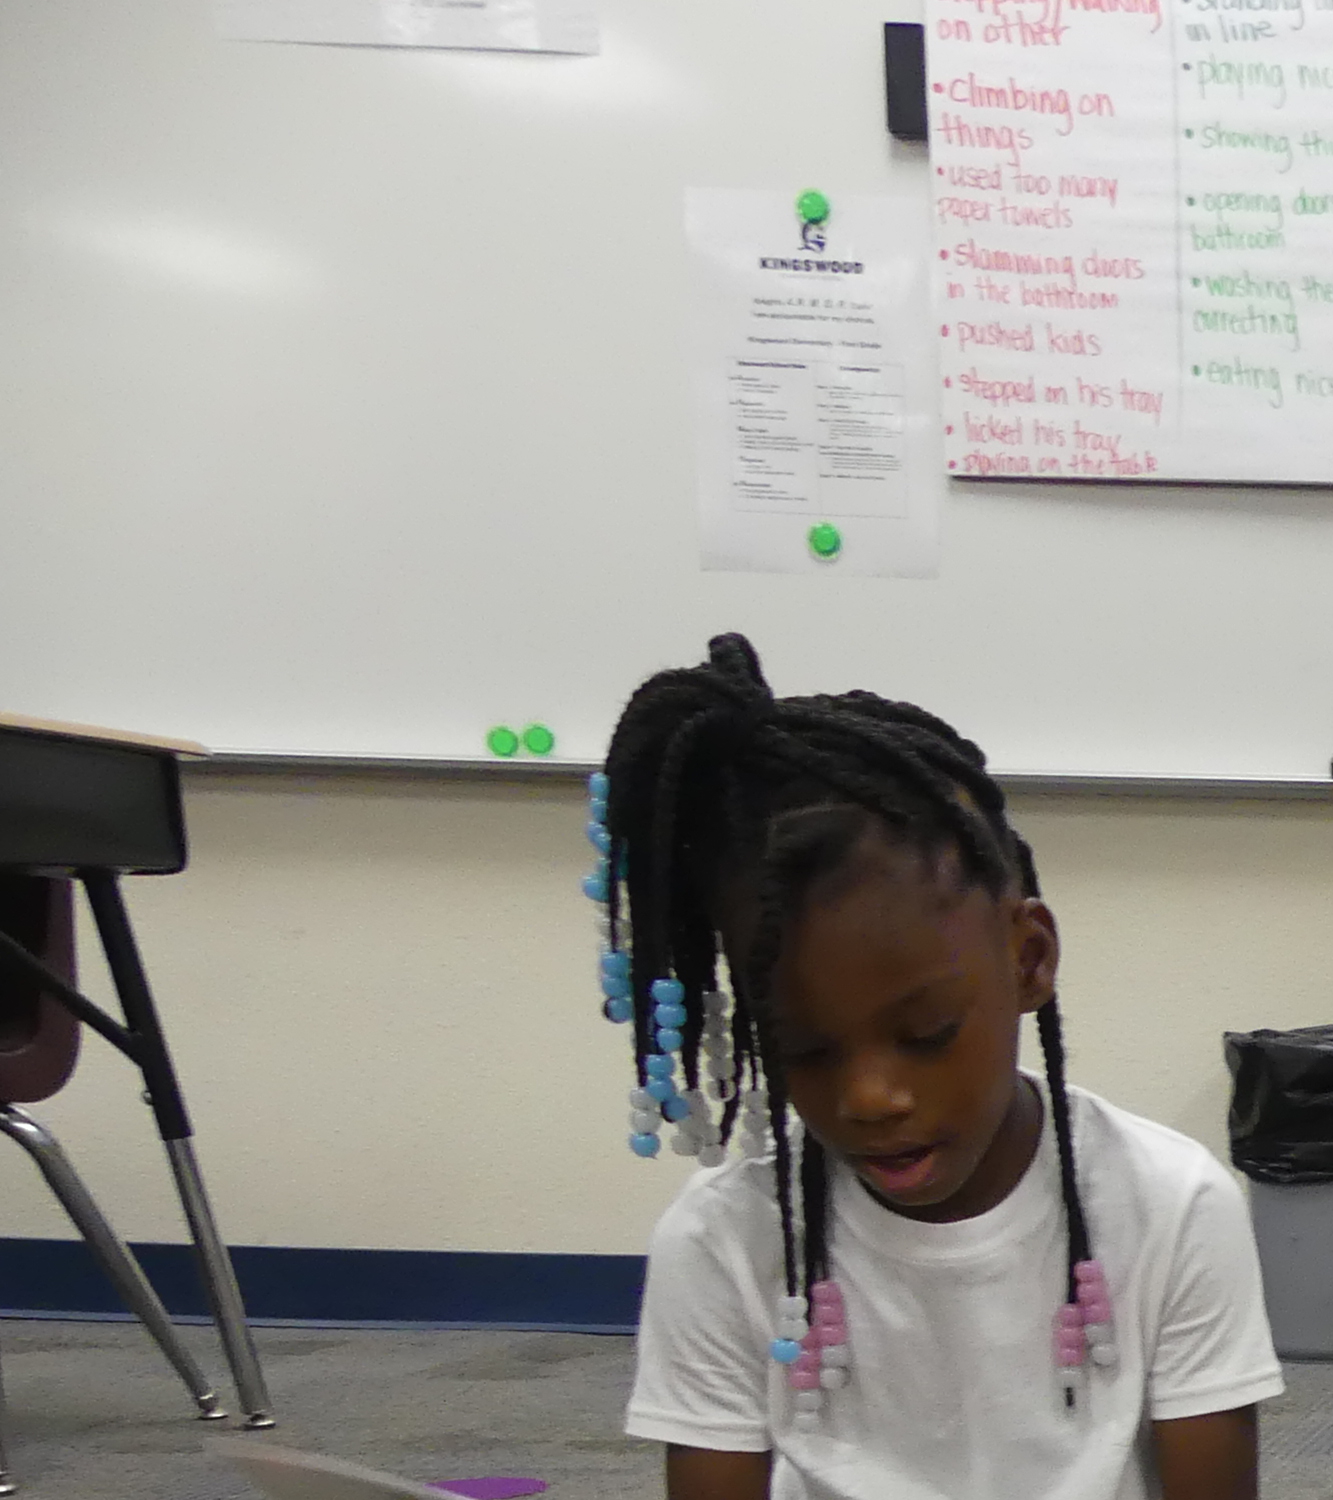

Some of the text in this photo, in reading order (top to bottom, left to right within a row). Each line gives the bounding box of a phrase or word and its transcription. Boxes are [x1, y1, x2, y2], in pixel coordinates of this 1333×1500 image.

[937, 19, 972, 42] on
[1218, 15, 1278, 43] line
[1198, 52, 1287, 110] playing
[1077, 93, 1115, 117] on
[937, 112, 1034, 167] things
[951, 164, 1002, 190] used
[998, 197, 1073, 229] towels
[1190, 222, 1286, 251] bathroom
[759, 257, 865, 274] KINGSWOOD
[1081, 249, 1146, 280] doors
[973, 276, 1011, 304] the
[957, 321, 1102, 356] pushed kids
[1207, 356, 1284, 410] eating
[1076, 376, 1114, 408] his
[1120, 378, 1164, 427] tray
[1034, 418, 1067, 447] his
[1073, 420, 1122, 460] tray
